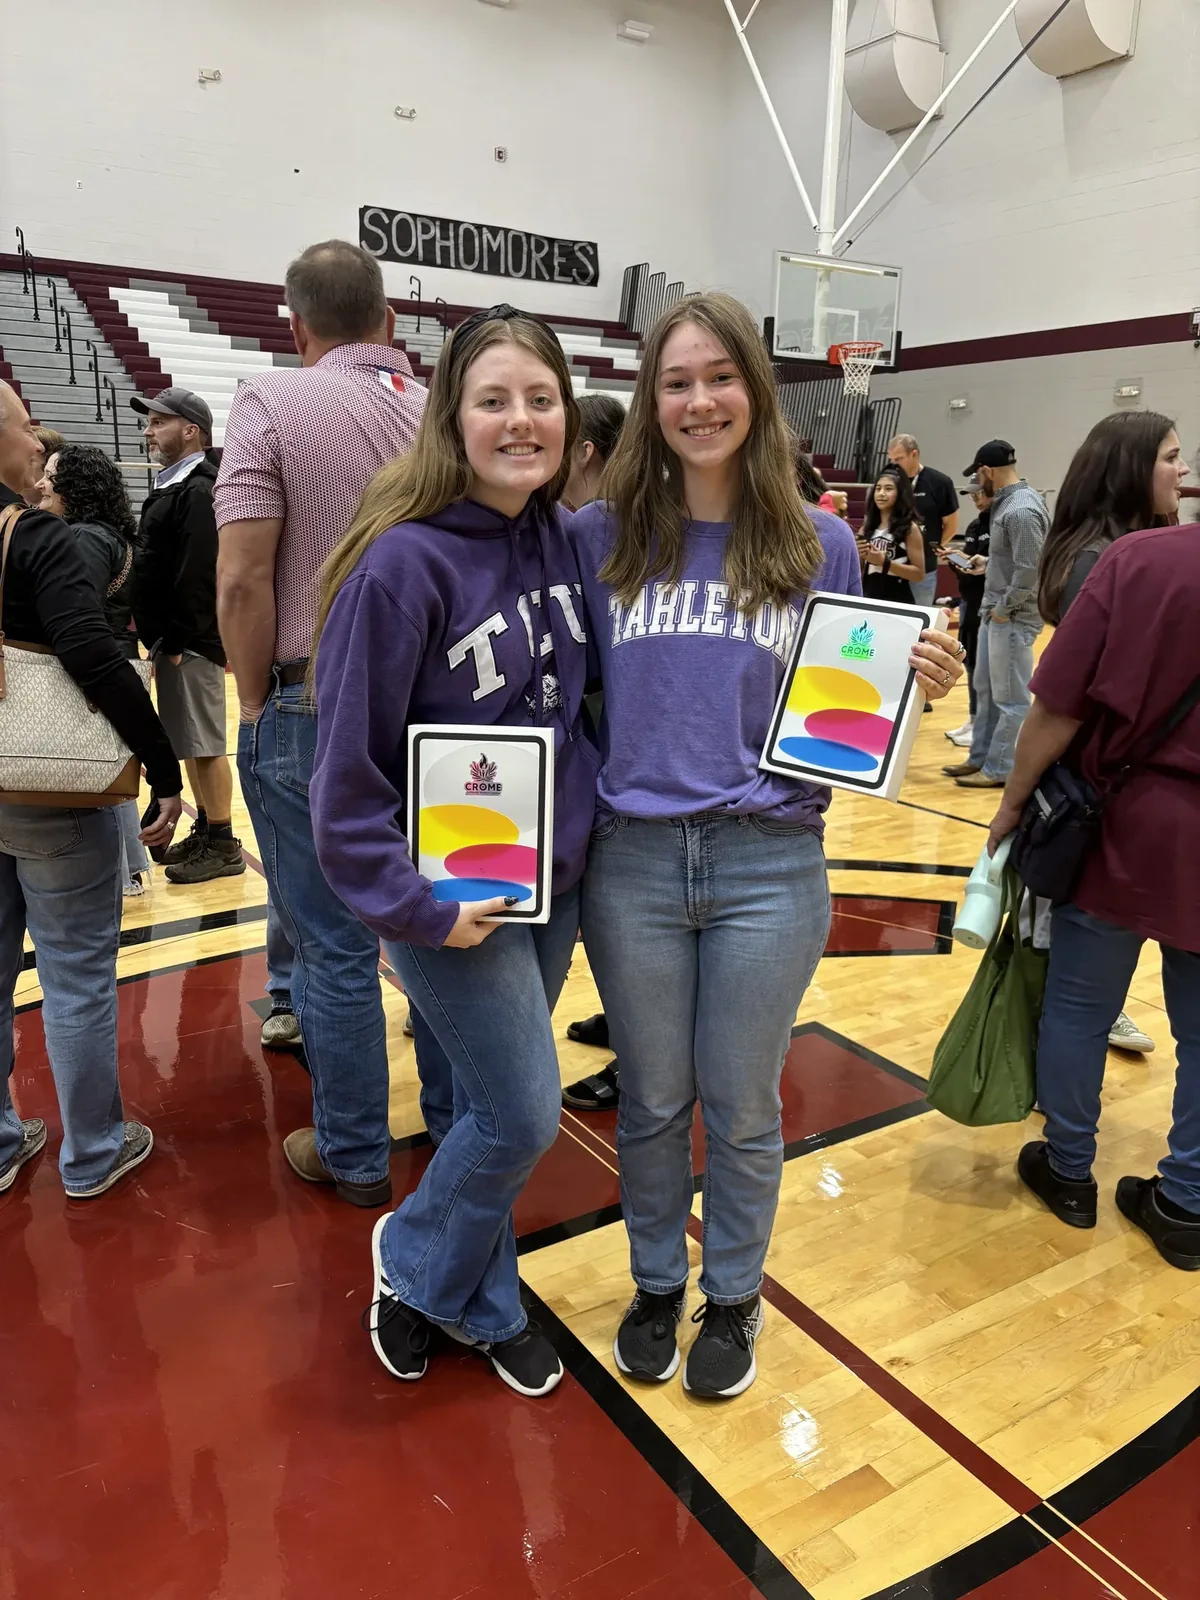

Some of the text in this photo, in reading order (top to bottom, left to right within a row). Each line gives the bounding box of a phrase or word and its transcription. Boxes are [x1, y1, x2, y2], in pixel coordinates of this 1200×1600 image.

[361, 208, 595, 286] SOPHOMORES
[840, 645, 875, 657] CROME
[464, 782, 502, 792] CROME
